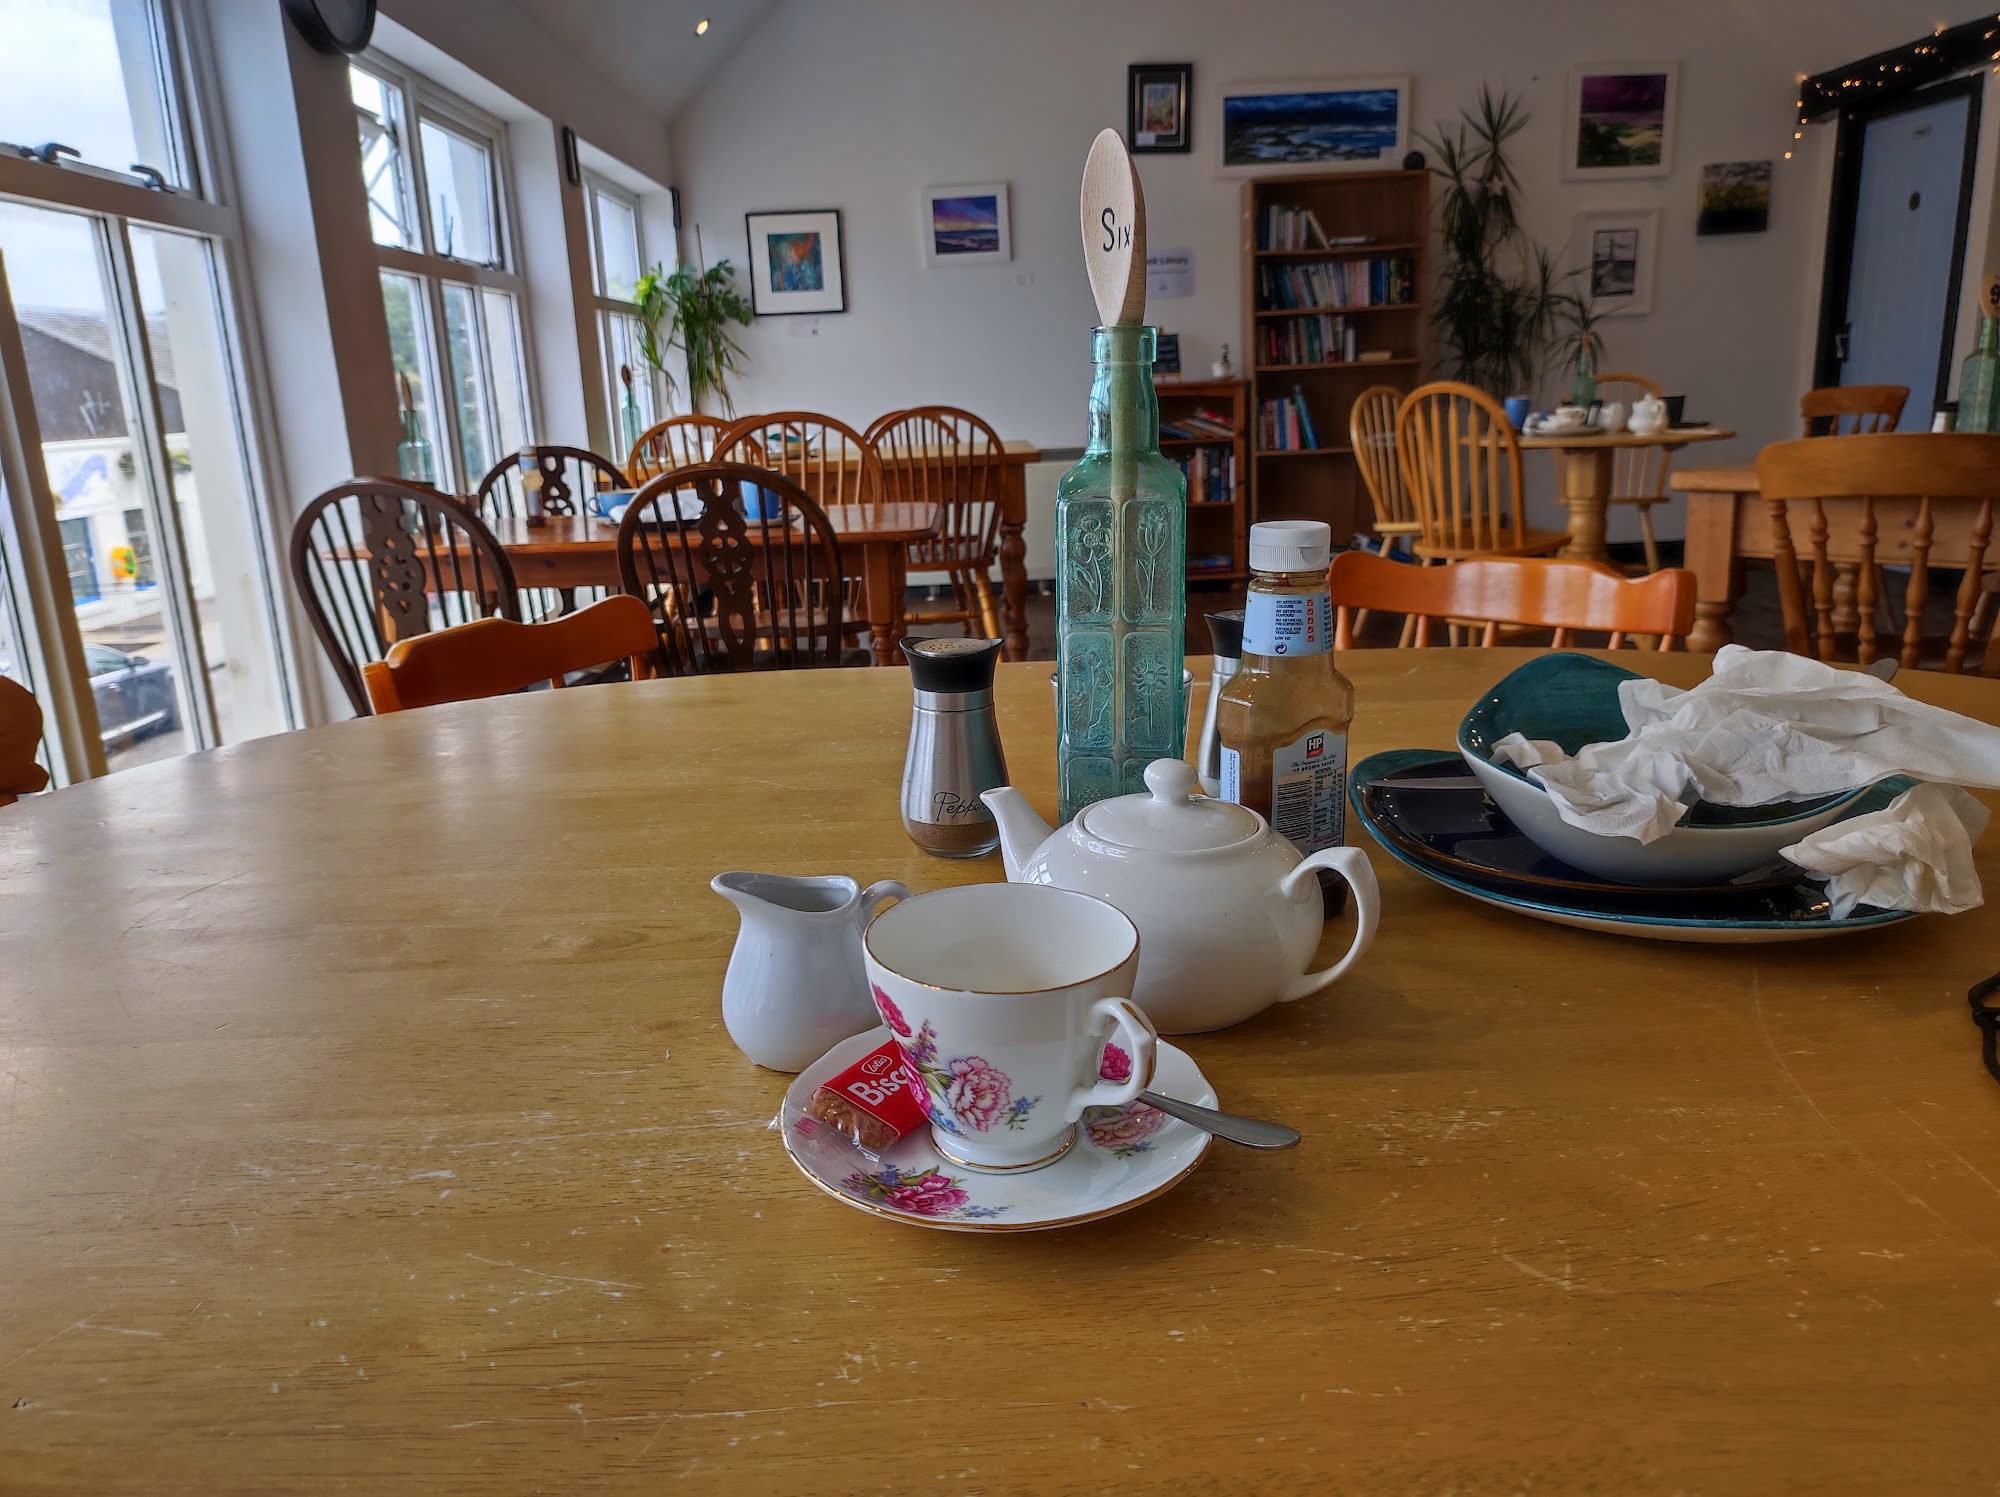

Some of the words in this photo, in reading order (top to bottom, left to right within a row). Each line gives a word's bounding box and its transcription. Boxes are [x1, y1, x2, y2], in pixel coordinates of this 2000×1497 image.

[1308, 737, 1323, 751] HP
[867, 1056, 888, 1073] Lotus
[847, 1065, 909, 1106] Bisc
